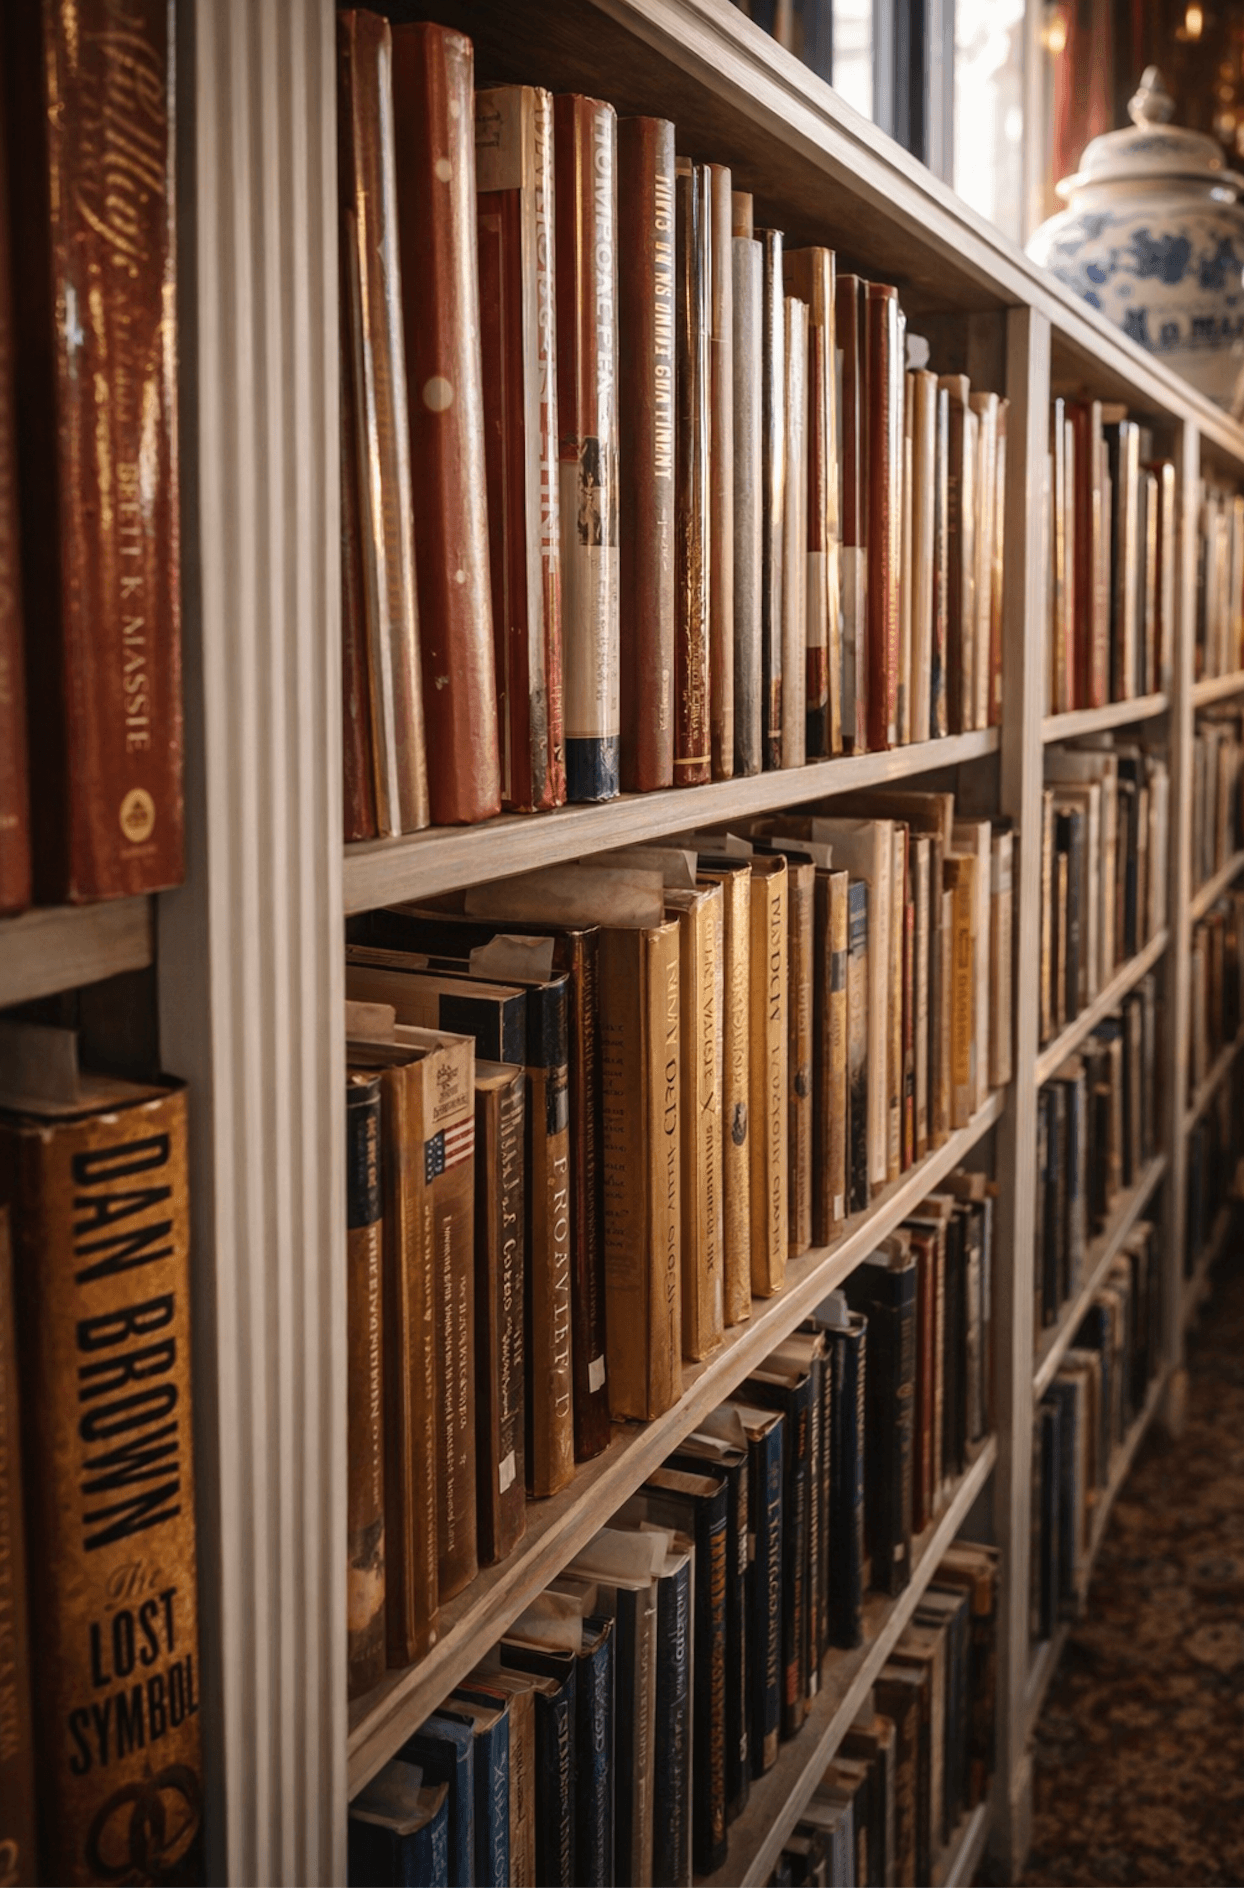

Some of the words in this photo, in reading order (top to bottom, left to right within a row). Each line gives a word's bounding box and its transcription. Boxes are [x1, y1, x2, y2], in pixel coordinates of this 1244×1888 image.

[119, 576, 144, 599] K
[122, 615, 150, 752] MASSIE
[72, 1132, 174, 1285] DAN
[76, 1291, 182, 1552] BROWN
[89, 1586, 177, 1688] LOST
[68, 1653, 199, 1776] SYMBOL
